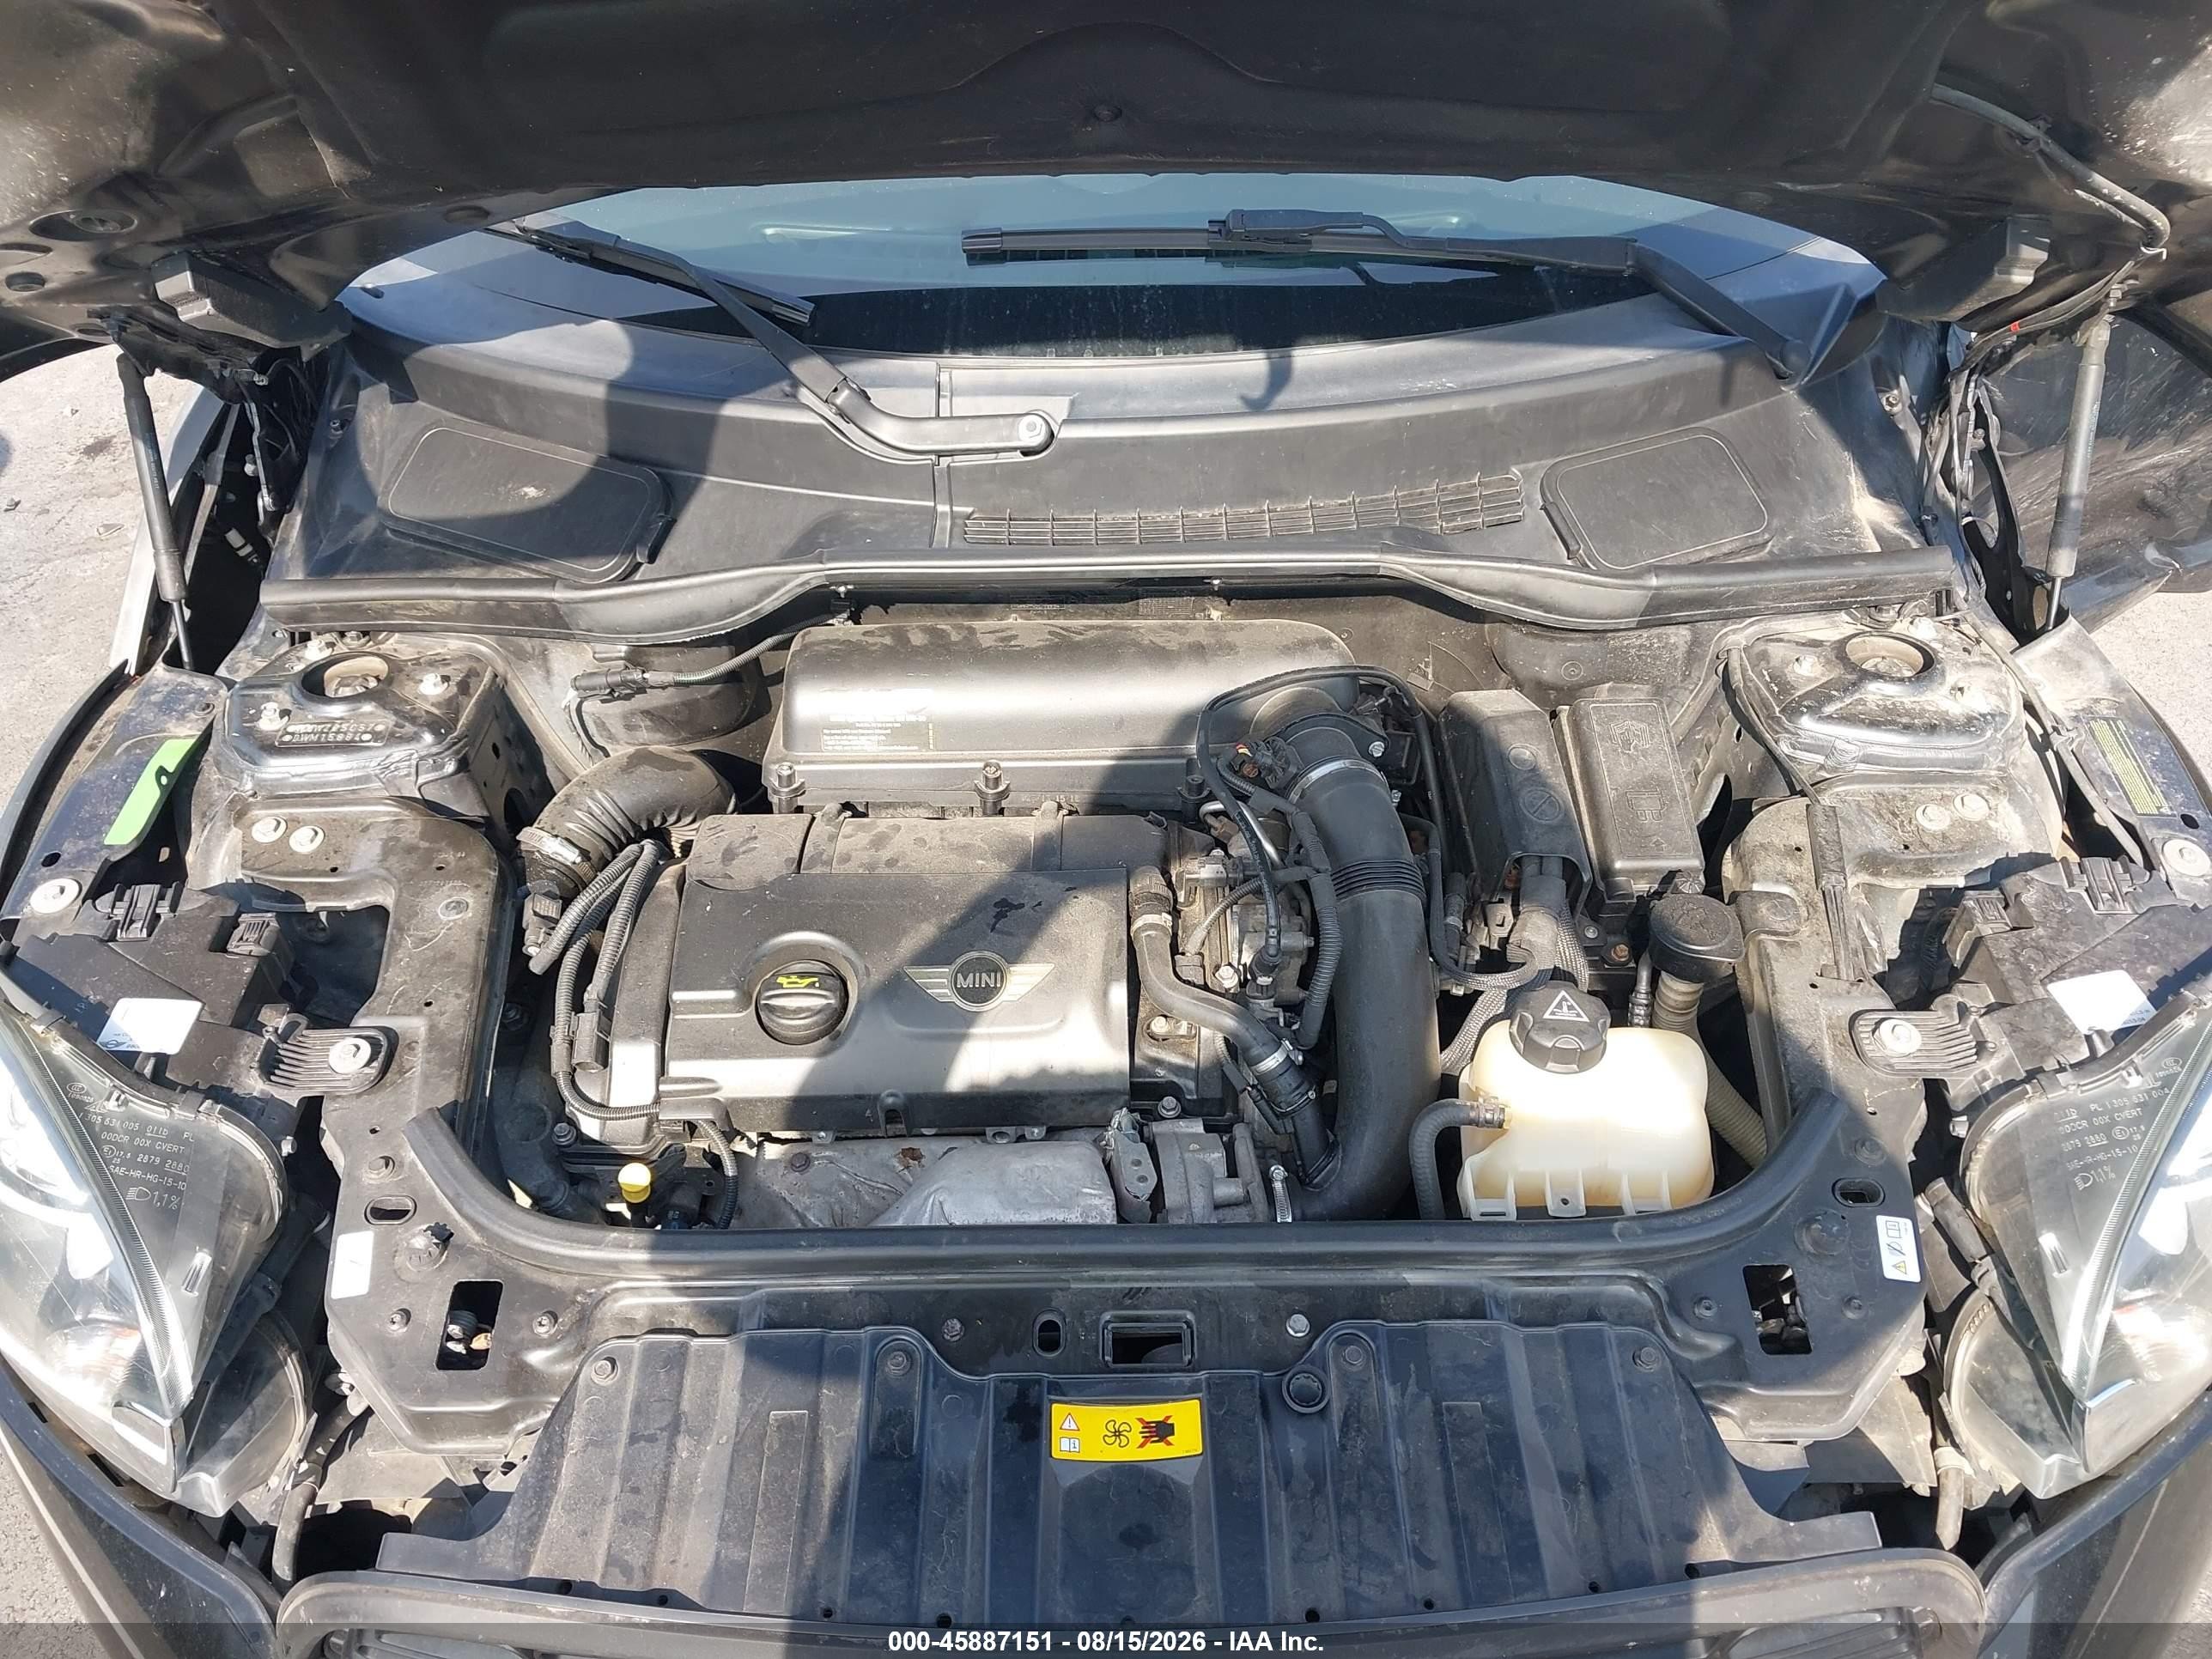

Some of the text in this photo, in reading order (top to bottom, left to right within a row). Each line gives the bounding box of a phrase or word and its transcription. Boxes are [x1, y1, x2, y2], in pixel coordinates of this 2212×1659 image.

[957, 972, 1001, 988] MINI
[2112, 1097, 2130, 1107] 305
[2093, 1114, 2111, 1126] 00X
[2114, 1108, 2143, 1121] CVERT
[85, 1113, 102, 1123] 305
[104, 1117, 120, 1127] 631
[123, 1121, 140, 1131] 005
[183, 1132, 195, 1142] PL
[101, 1132, 185, 1154] 00DCR 00X CVERT
[137, 1154, 161, 1165] 2879
[165, 1159, 190, 1172] 2880
[108, 1164, 187, 1191] SAE-HR-HG-15-10
